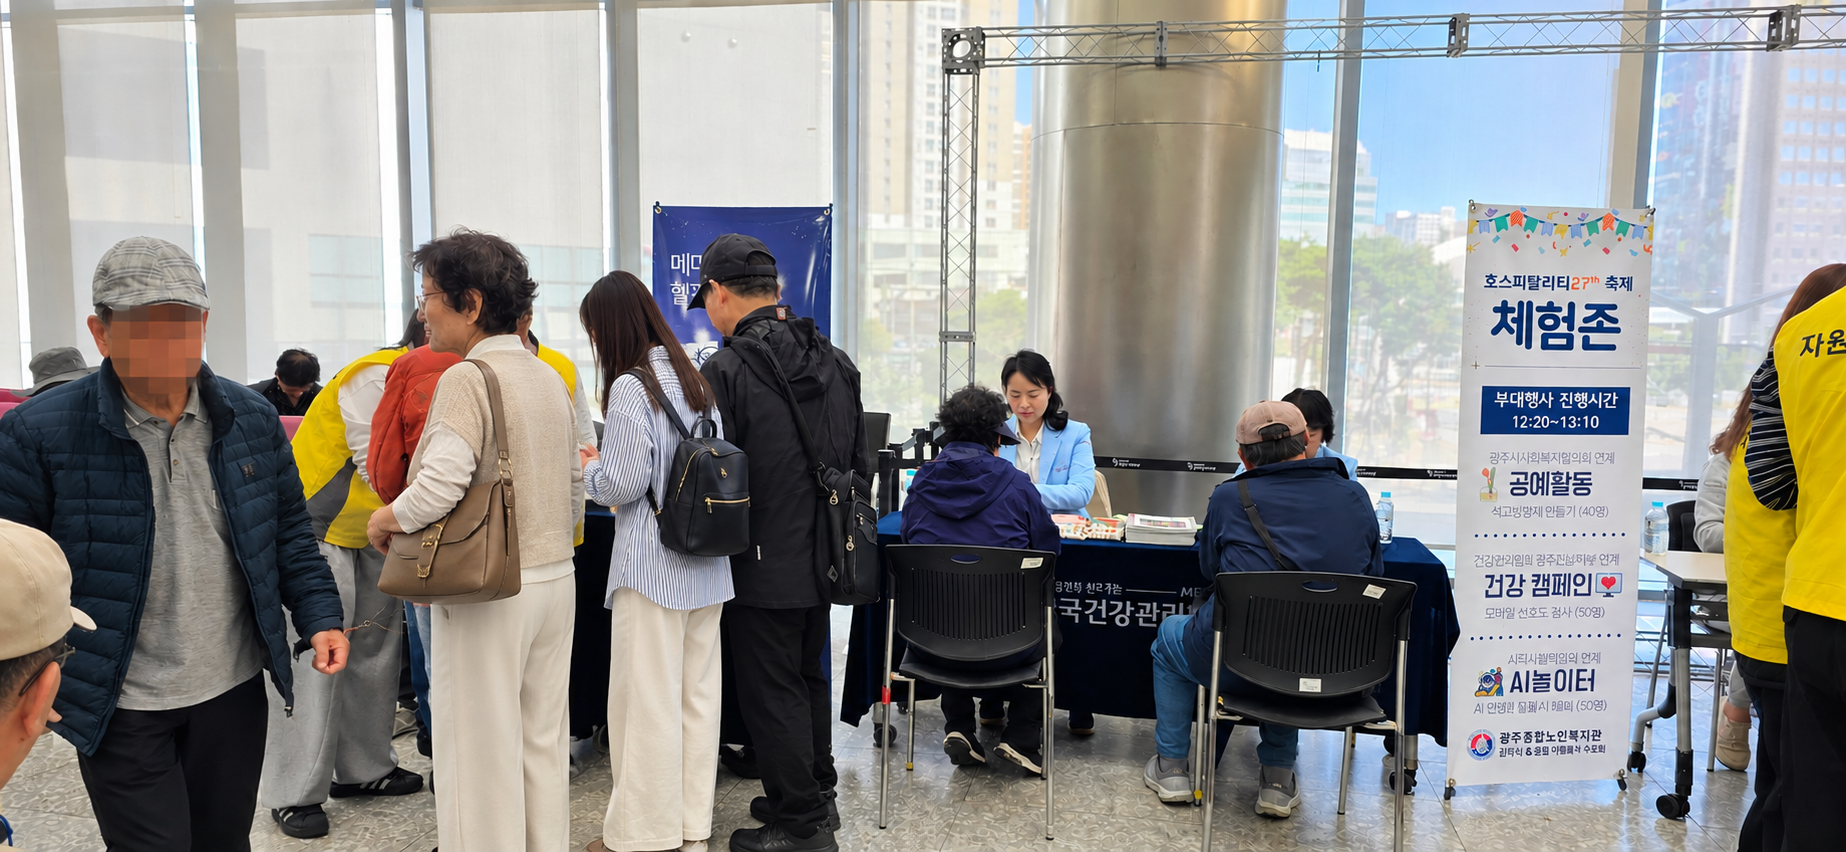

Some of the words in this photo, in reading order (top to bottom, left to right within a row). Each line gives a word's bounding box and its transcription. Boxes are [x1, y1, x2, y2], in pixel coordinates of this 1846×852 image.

[1604, 275, 1633, 292] 축제
[1490, 299, 1622, 351] 체험존
[1494, 391, 1554, 409] 부대행사
[1559, 391, 1619, 409] 진행시간
[1512, 415, 1600, 430] 12:20~13:10
[1509, 470, 1593, 497] 공예활동
[1484, 573, 1526, 598] 건강
[1531, 572, 1593, 598] 캠페인
[1055, 597, 1194, 627] 국건강관리
[1518, 606, 1549, 619] 선호도
[1509, 668, 1596, 694] AI놀이터
